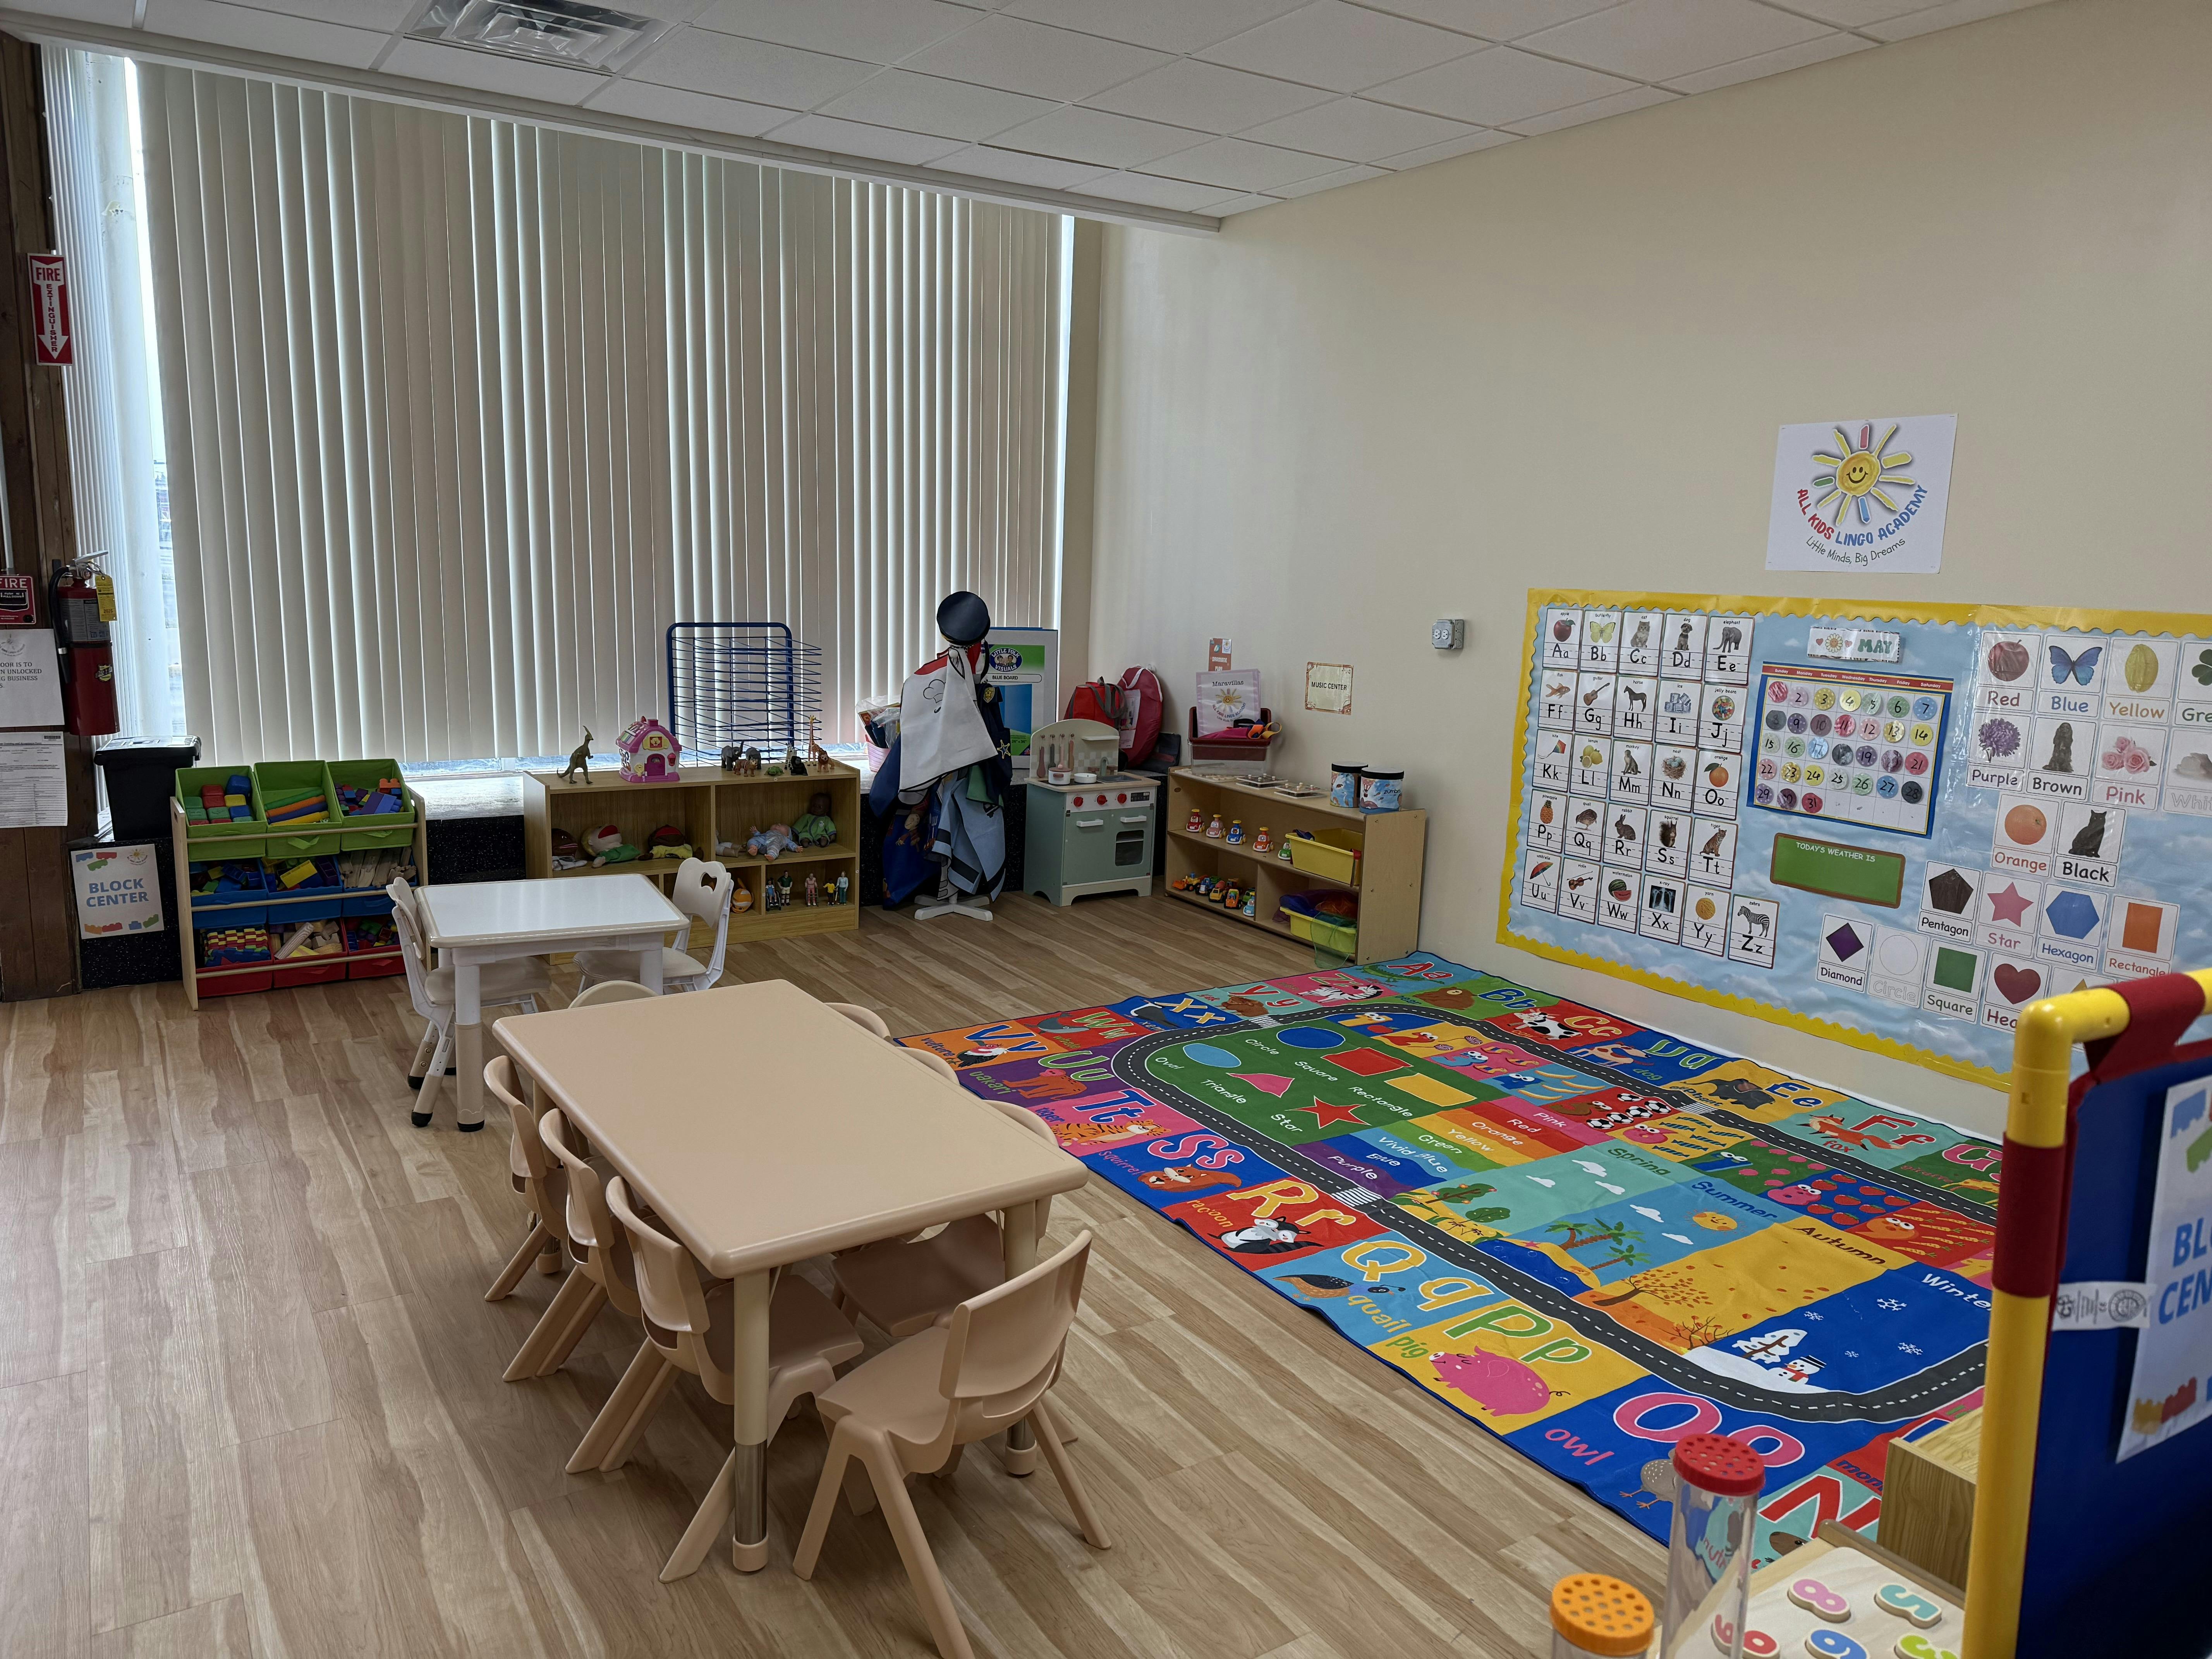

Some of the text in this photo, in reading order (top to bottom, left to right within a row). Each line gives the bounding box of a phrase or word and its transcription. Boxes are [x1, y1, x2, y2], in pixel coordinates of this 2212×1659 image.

[36, 267, 60, 282] FIRE
[46, 284, 58, 352] EXTINGUISHER
[1797, 484, 1928, 546] ALL KIDS LINGO ACADEMY
[1806, 536, 1906, 566] Little Minds, Big Dreams
[991, 648, 1020, 658] LITTLE FOLK
[1553, 643, 1568, 658] Aa
[1591, 646, 1606, 661] Bb
[1630, 648, 1647, 664] Cc
[1858, 639, 1893, 654] MAY
[1673, 651, 1691, 668] Dd
[1717, 655, 1736, 672] Ee
[1795, 692, 1930, 714] 2 3 4 5 6 7
[1988, 690, 2020, 706] Red
[2051, 696, 2089, 713] Blue
[1548, 704, 1563, 719] Ff
[1585, 708, 1601, 730] Gg
[1624, 712, 1642, 729] Hh
[2109, 702, 2165, 719] Yellow
[1669, 717, 1681, 734] Ii
[1711, 722, 1728, 747] Jj
[1793, 718, 1928, 740] 9 10 11 12 13 14
[1765, 738, 1923, 770] 15 16 19 21
[1543, 763, 1558, 780] Kk
[1582, 769, 1594, 786] Ll
[1761, 764, 1773, 774] 22
[1784, 767, 1797, 778] 23
[1807, 770, 1820, 780] 24
[1831, 772, 1843, 784] 25
[1855, 778, 1870, 790] 26
[1879, 780, 1894, 793] 27
[1972, 768, 2018, 786] Purple
[1619, 776, 1640, 793] Mm
[1662, 781, 1680, 799] Nn
[2032, 777, 2082, 796] Brown
[1705, 788, 1724, 806] Oo
[1758, 788, 1817, 809] 29 31
[2106, 786, 2145, 805] Pink
[1538, 824, 1552, 847] Pp
[1574, 832, 1591, 856] Qq
[1615, 839, 1631, 856] Rr
[1657, 847, 1674, 865] Ss
[1796, 842, 1825, 853] TODAY'S
[1828, 848, 1863, 860] WEATHER
[1703, 856, 1720, 874] Tt
[1994, 851, 2047, 873] Orange
[2063, 861, 2110, 883] Black
[89, 878, 144, 894] BLOCK
[1532, 883, 1546, 900] Uu
[86, 891, 149, 907] CENTER
[1570, 893, 1585, 910] Vv
[1607, 901, 1629, 920] Ww
[1651, 912, 1670, 931] Xx
[1921, 917, 1969, 938] Pentagon
[1694, 922, 1712, 948] Yy
[1741, 934, 1763, 954] Zz
[1988, 932, 2021, 950] Star
[2042, 943, 2094, 964] Hexagon
[1386, 960, 1454, 981] Aa
[1820, 967, 1863, 986] Diamond
[2109, 958, 2166, 977] Rectangle
[1227, 984, 1302, 1009] Yy
[1477, 988, 1537, 1009] Bb
[1873, 980, 1917, 1002] Circle
[1154, 997, 1226, 1025] Xx
[1927, 994, 1973, 1016] Square
[1071, 1011, 1137, 1040] Ww
[1563, 1015, 1623, 1037] Cc
[920, 1037, 956, 1058] vulture
[963, 1024, 1049, 1053] Vv
[1244, 1038, 1280, 1056] Circle
[1038, 1050, 1115, 1082] Uu
[1154, 1056, 1185, 1070] Oval
[1293, 1060, 1339, 1082] Square
[969, 1069, 1018, 1096] uakari
[1632, 1067, 1664, 1081] dog
[1200, 1078, 1247, 1105] Triangle
[1348, 1085, 1413, 1118] Rectangle
[1764, 1082, 1824, 1108] Ee
[1072, 1089, 1158, 1123] Tt
[1269, 1113, 1304, 1134] Star
[1506, 1119, 1542, 1134] Red
[1533, 1111, 1567, 1127] Pink
[1448, 1128, 1496, 1153] Yellow
[1471, 1121, 1523, 1146] Orange
[1850, 1114, 1937, 1146] Ff
[1147, 1134, 1245, 1171] Ss
[1417, 1133, 1463, 1155] Green
[1822, 1140, 1855, 1153] fox
[1097, 1149, 1146, 1177] squirrel
[1365, 1152, 1401, 1168] Blue
[1377, 1137, 1448, 1175] Vivid Blue
[1607, 1147, 1671, 1176] Spring
[1327, 1155, 1379, 1181] Purple
[1225, 1179, 1357, 1227] Rr
[1691, 1181, 1778, 1220] Summer
[1793, 1226, 1886, 1266] Autumn
[1340, 1239, 1494, 1312] Qq
[1347, 1294, 1412, 1334] quail
[1443, 1304, 1593, 1364] Pp
[1386, 1333, 1431, 1359] pig
[1544, 1428, 1615, 1466] owl
[1793, 1578, 1848, 1613] 8
[1880, 1584, 1939, 1620] 5
